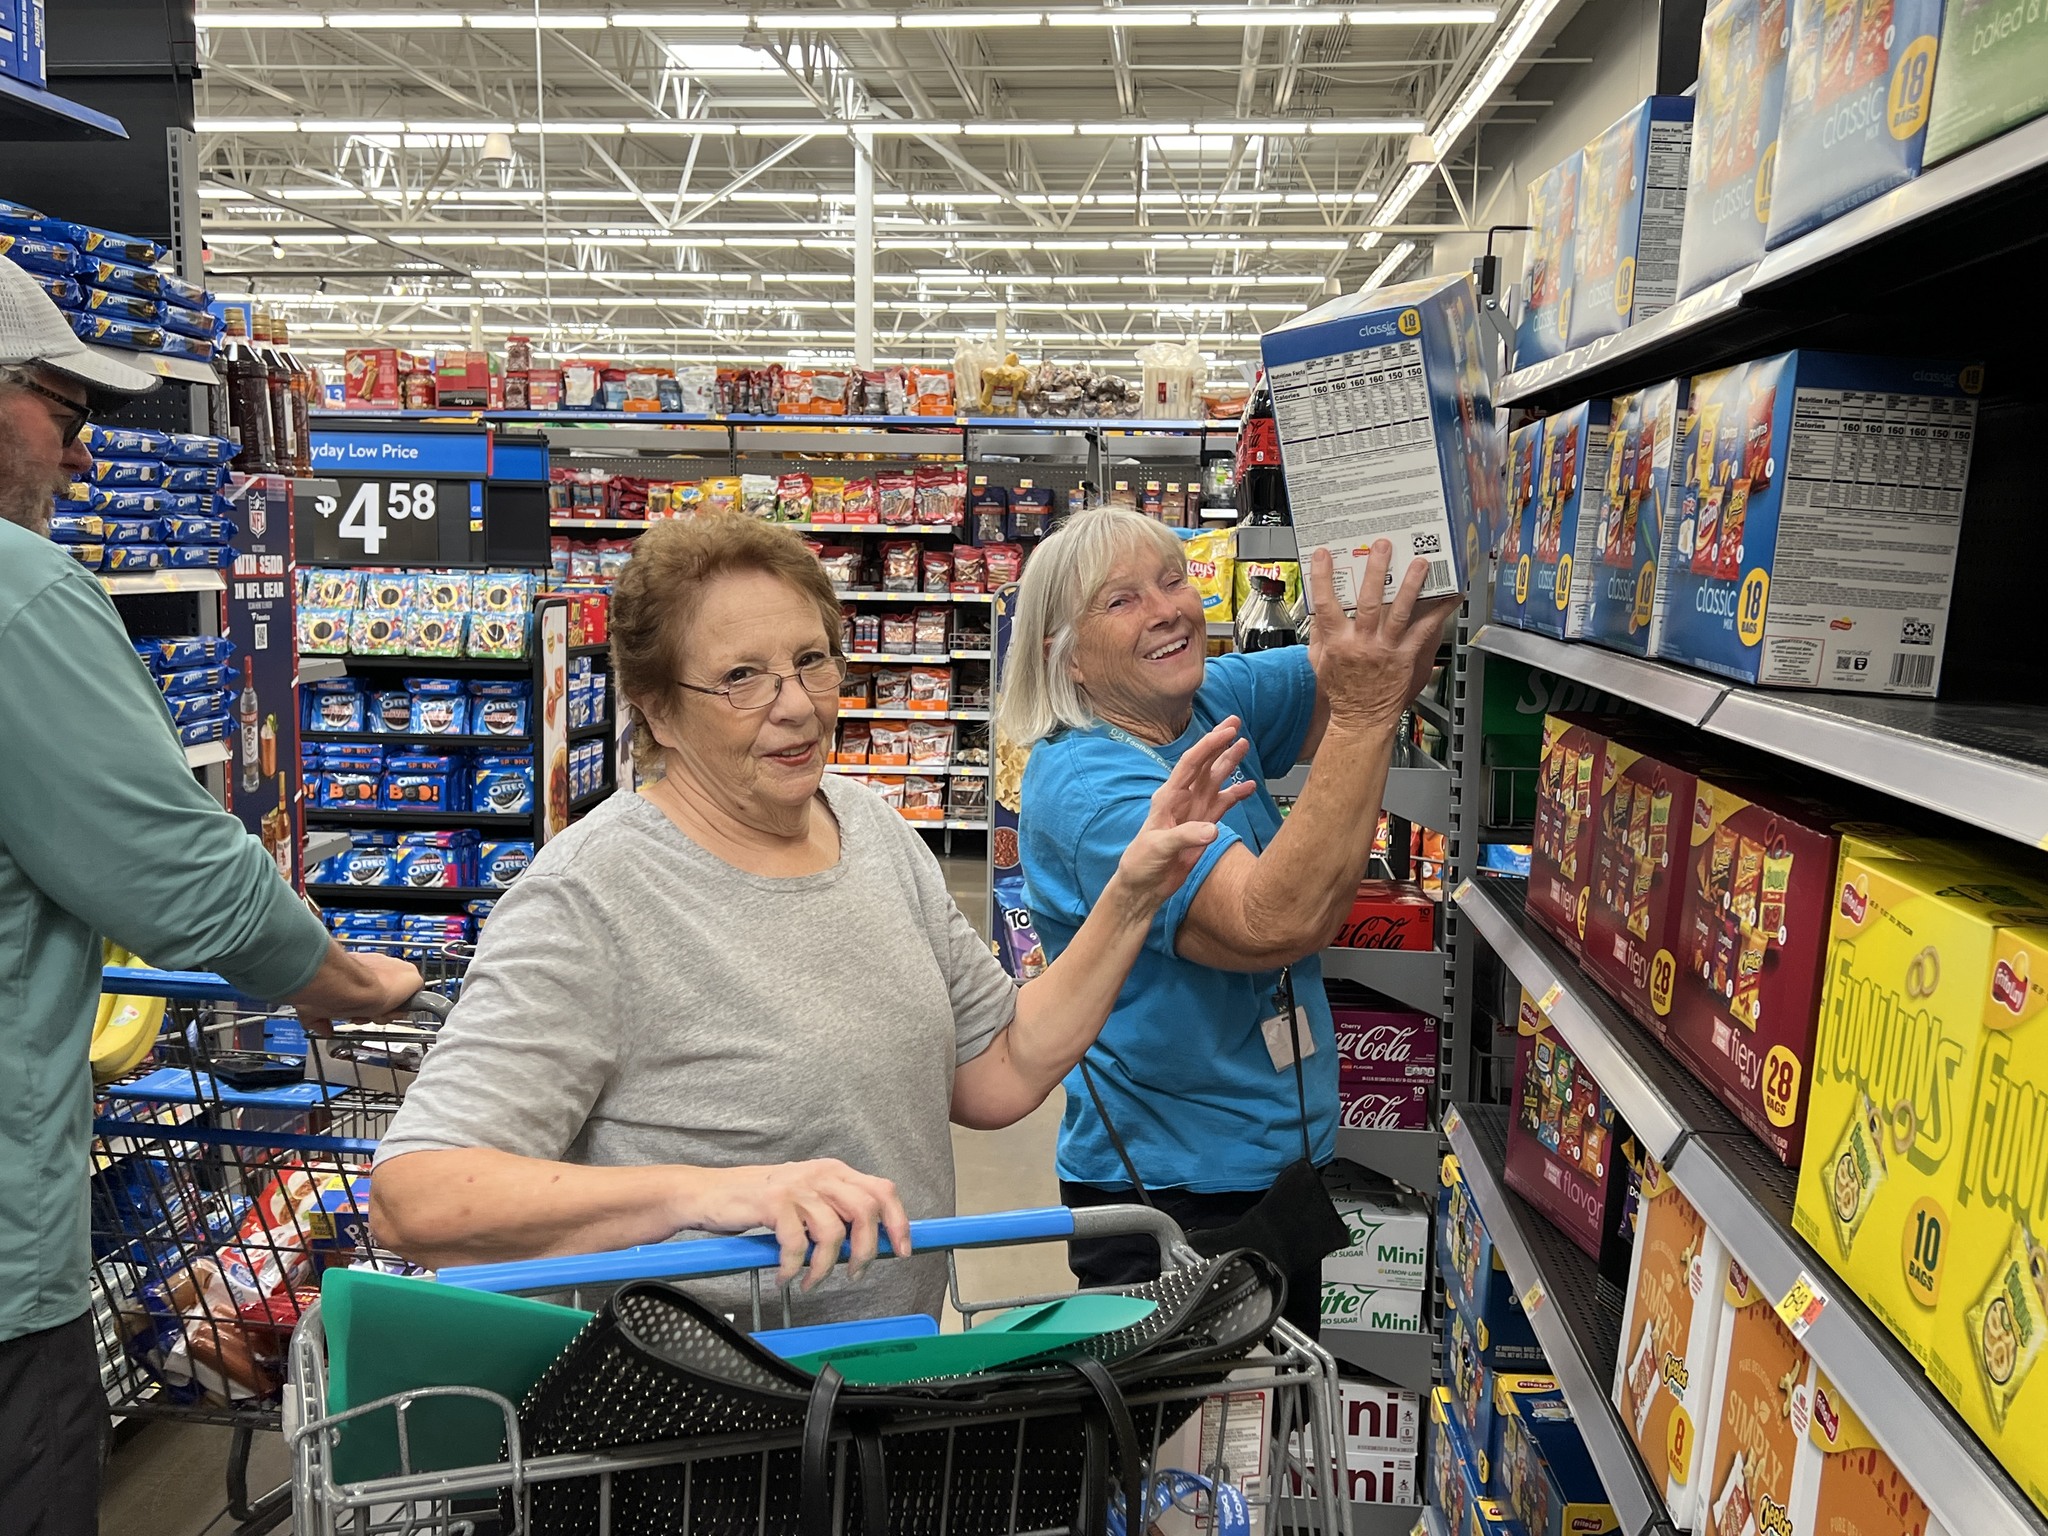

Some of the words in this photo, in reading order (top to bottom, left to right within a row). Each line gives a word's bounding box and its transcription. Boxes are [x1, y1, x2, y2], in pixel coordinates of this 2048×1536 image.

[1972, 7, 2024, 57] baked
[1898, 51, 1929, 109] 18
[1822, 82, 1885, 150] classic
[1894, 105, 1921, 128] BAGS
[1864, 122, 1881, 143] MIX
[1650, 144, 1673, 152] Calories
[1712, 175, 1754, 226] classic
[103, 239, 126, 248] OREO
[1619, 263, 1631, 297] 18
[1588, 279, 1615, 311] classic
[1359, 321, 1397, 338] classic
[1402, 313, 1417, 329] 18
[1274, 391, 1301, 402] Calories
[1313, 385, 1328, 395] 160
[1331, 381, 1347, 391] 160
[1349, 378, 1366, 388] 160
[1368, 374, 1384, 384] 160
[1387, 370, 1404, 380] 150
[1407, 367, 1423, 377] 150
[1912, 369, 1957, 384] classic
[1965, 369, 1980, 385] 18
[1794, 421, 1826, 430] Calories
[1842, 423, 1860, 432] 160
[1865, 424, 1882, 433] 160
[1887, 426, 1905, 435] 160
[1909, 427, 1927, 437] 160
[1932, 429, 1949, 438] 150
[1953, 431, 1971, 440] 150
[117, 439, 138, 450] OREO
[184, 442, 203, 453] OREO
[310, 444, 347, 460] yday
[349, 444, 378, 459] Low
[382, 444, 419, 459] Price
[115, 469, 137, 479] OREO
[184, 470, 203, 482] OREO
[116, 497, 140, 509] OREO
[177, 495, 197, 507] OREO
[118, 528, 139, 540] OREO
[188, 522, 207, 534] OREO
[128, 555, 147, 566] OREO
[184, 550, 204, 560] OREO
[234, 554, 257, 576] WIN
[259, 554, 284, 575] $500
[1502, 563, 1517, 586] classic
[1518, 562, 1527, 587] 18
[1538, 565, 1557, 590] classic
[1558, 563, 1569, 590] 18
[234, 582, 245, 599] IN
[246, 582, 262, 599] NFL
[263, 582, 285, 599] GEAR
[1607, 572, 1636, 602] classic
[1639, 570, 1652, 605] 18
[1696, 577, 1737, 618] classic
[1745, 579, 1762, 621] 18
[1723, 618, 1733, 631] MIX
[1741, 619, 1757, 634] BAGS
[321, 694, 355, 706] OREO
[483, 700, 519, 712] OREO
[1124, 737, 1156, 759] Foothills
[396, 775, 430, 787] OREO
[488, 782, 526, 797] OREO
[329, 783, 379, 800] BOO!
[389, 785, 439, 801] BOO!
[349, 859, 387, 871] OREO
[407, 864, 445, 876] OREO
[491, 861, 530, 874] OREO
[1560, 881, 1578, 922] fiery
[1418, 907, 1430, 916] 10
[1626, 940, 1651, 989] fiery
[1653, 957, 1673, 995] 28
[1653, 992, 1667, 1007] BAGS
[1423, 1017, 1436, 1026] 10
[1731, 1028, 1763, 1090] fiery
[1740, 1072, 1751, 1091] MIX
[1767, 1054, 1794, 1103] 28
[1412, 1086, 1425, 1095] 10
[1767, 1095, 1787, 1117] BAGS
[1563, 1169, 1604, 1222] flavor
[1588, 1216, 1599, 1230] MIX
[1915, 1209, 1942, 1272] 10
[1338, 1250, 1364, 1258] SUGAR
[1377, 1245, 1424, 1265] Mini
[1384, 1269, 1423, 1277] LEMON-LIME
[1908, 1259, 1935, 1293] BAGS
[1640, 1267, 1684, 1353] SIMPLY
[1333, 1317, 1358, 1325] SUGAR
[1371, 1311, 1418, 1332] Mini
[1663, 1351, 1690, 1391] Cheetos
[1518, 1381, 1555, 1389] FritoLay
[1674, 1417, 1685, 1457] 8
[1727, 1389, 1784, 1498] SIMPLY
[1669, 1448, 1683, 1475] BAGS
[1759, 1492, 1794, 1536] Cheetos
[1573, 1519, 1602, 1531] FritoLay
